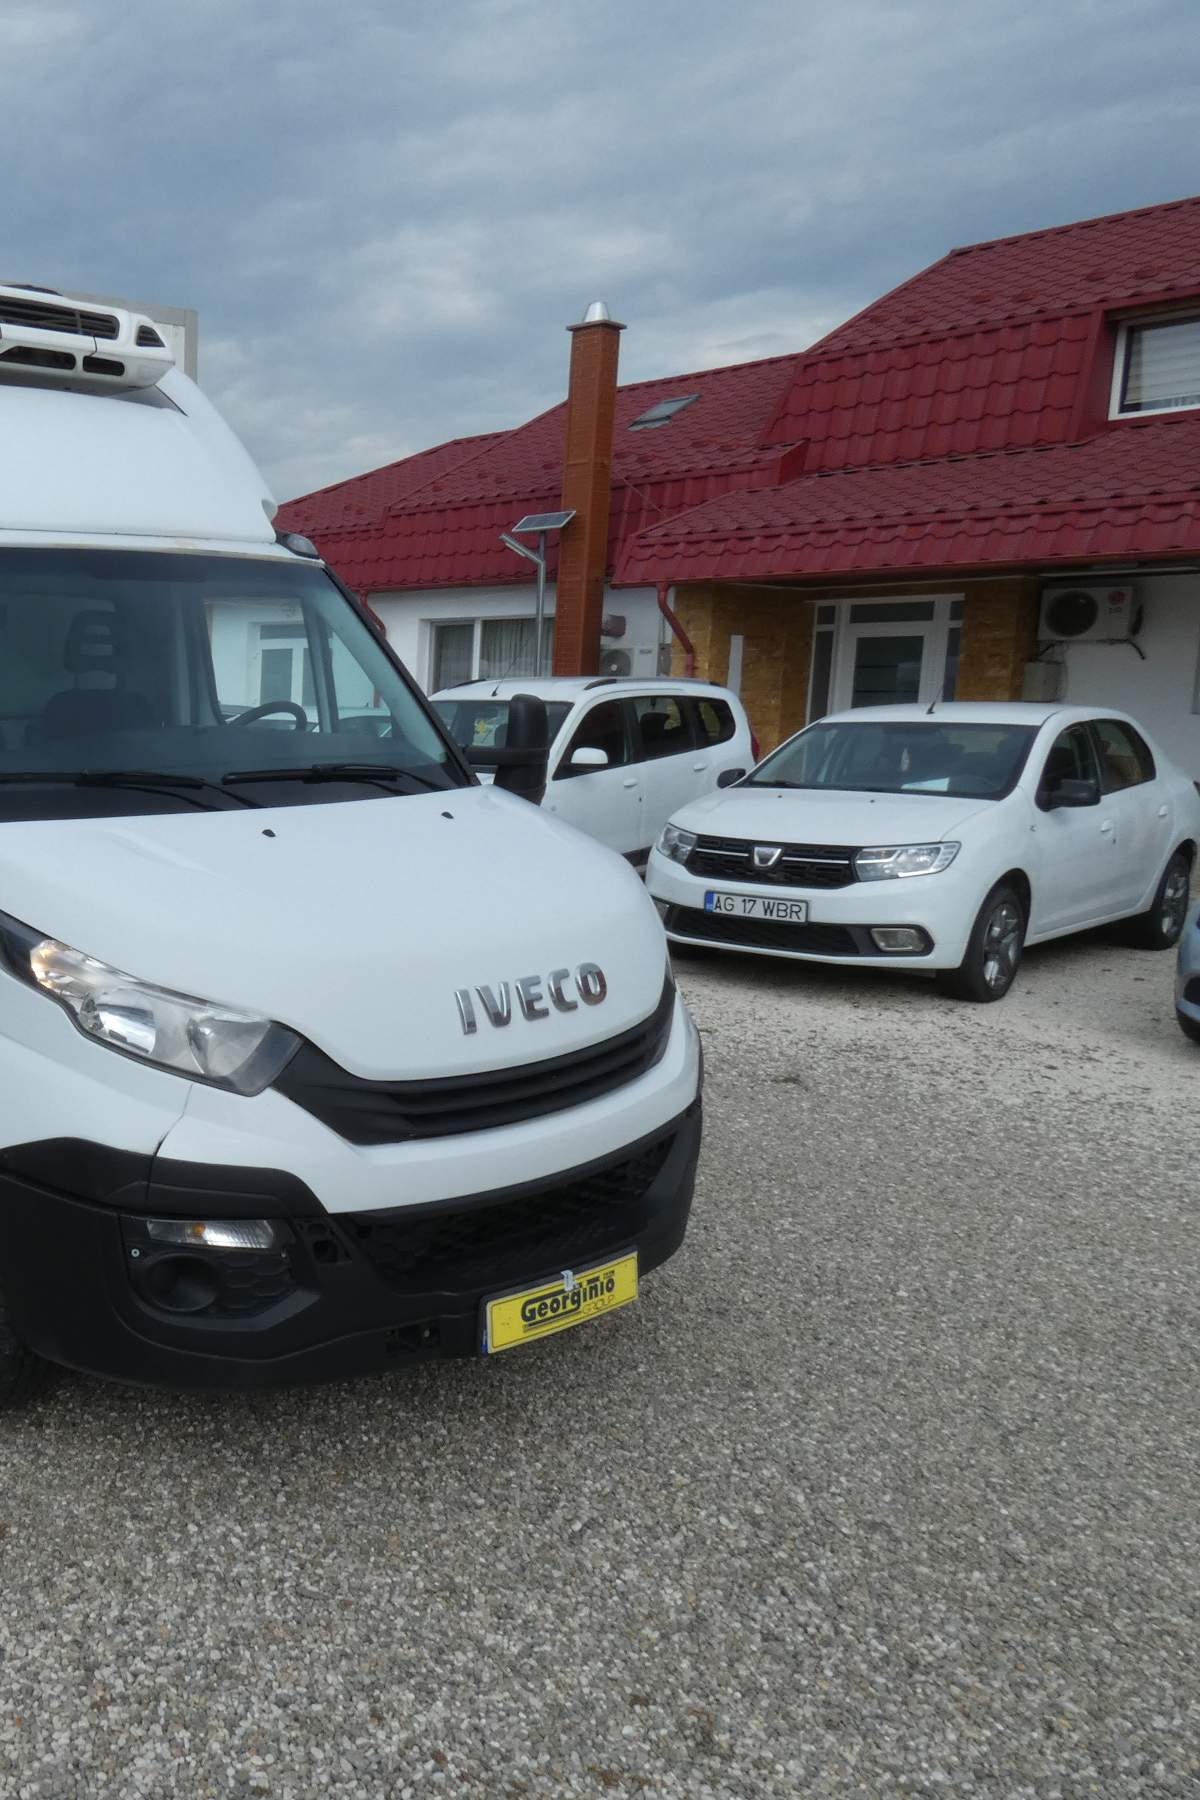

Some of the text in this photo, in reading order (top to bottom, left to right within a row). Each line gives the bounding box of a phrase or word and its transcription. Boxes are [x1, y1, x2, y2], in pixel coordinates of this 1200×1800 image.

[714, 896, 802, 920] AG 17 WBR
[454, 962, 608, 1035] IVECO
[521, 1278, 615, 1324] Georginio
